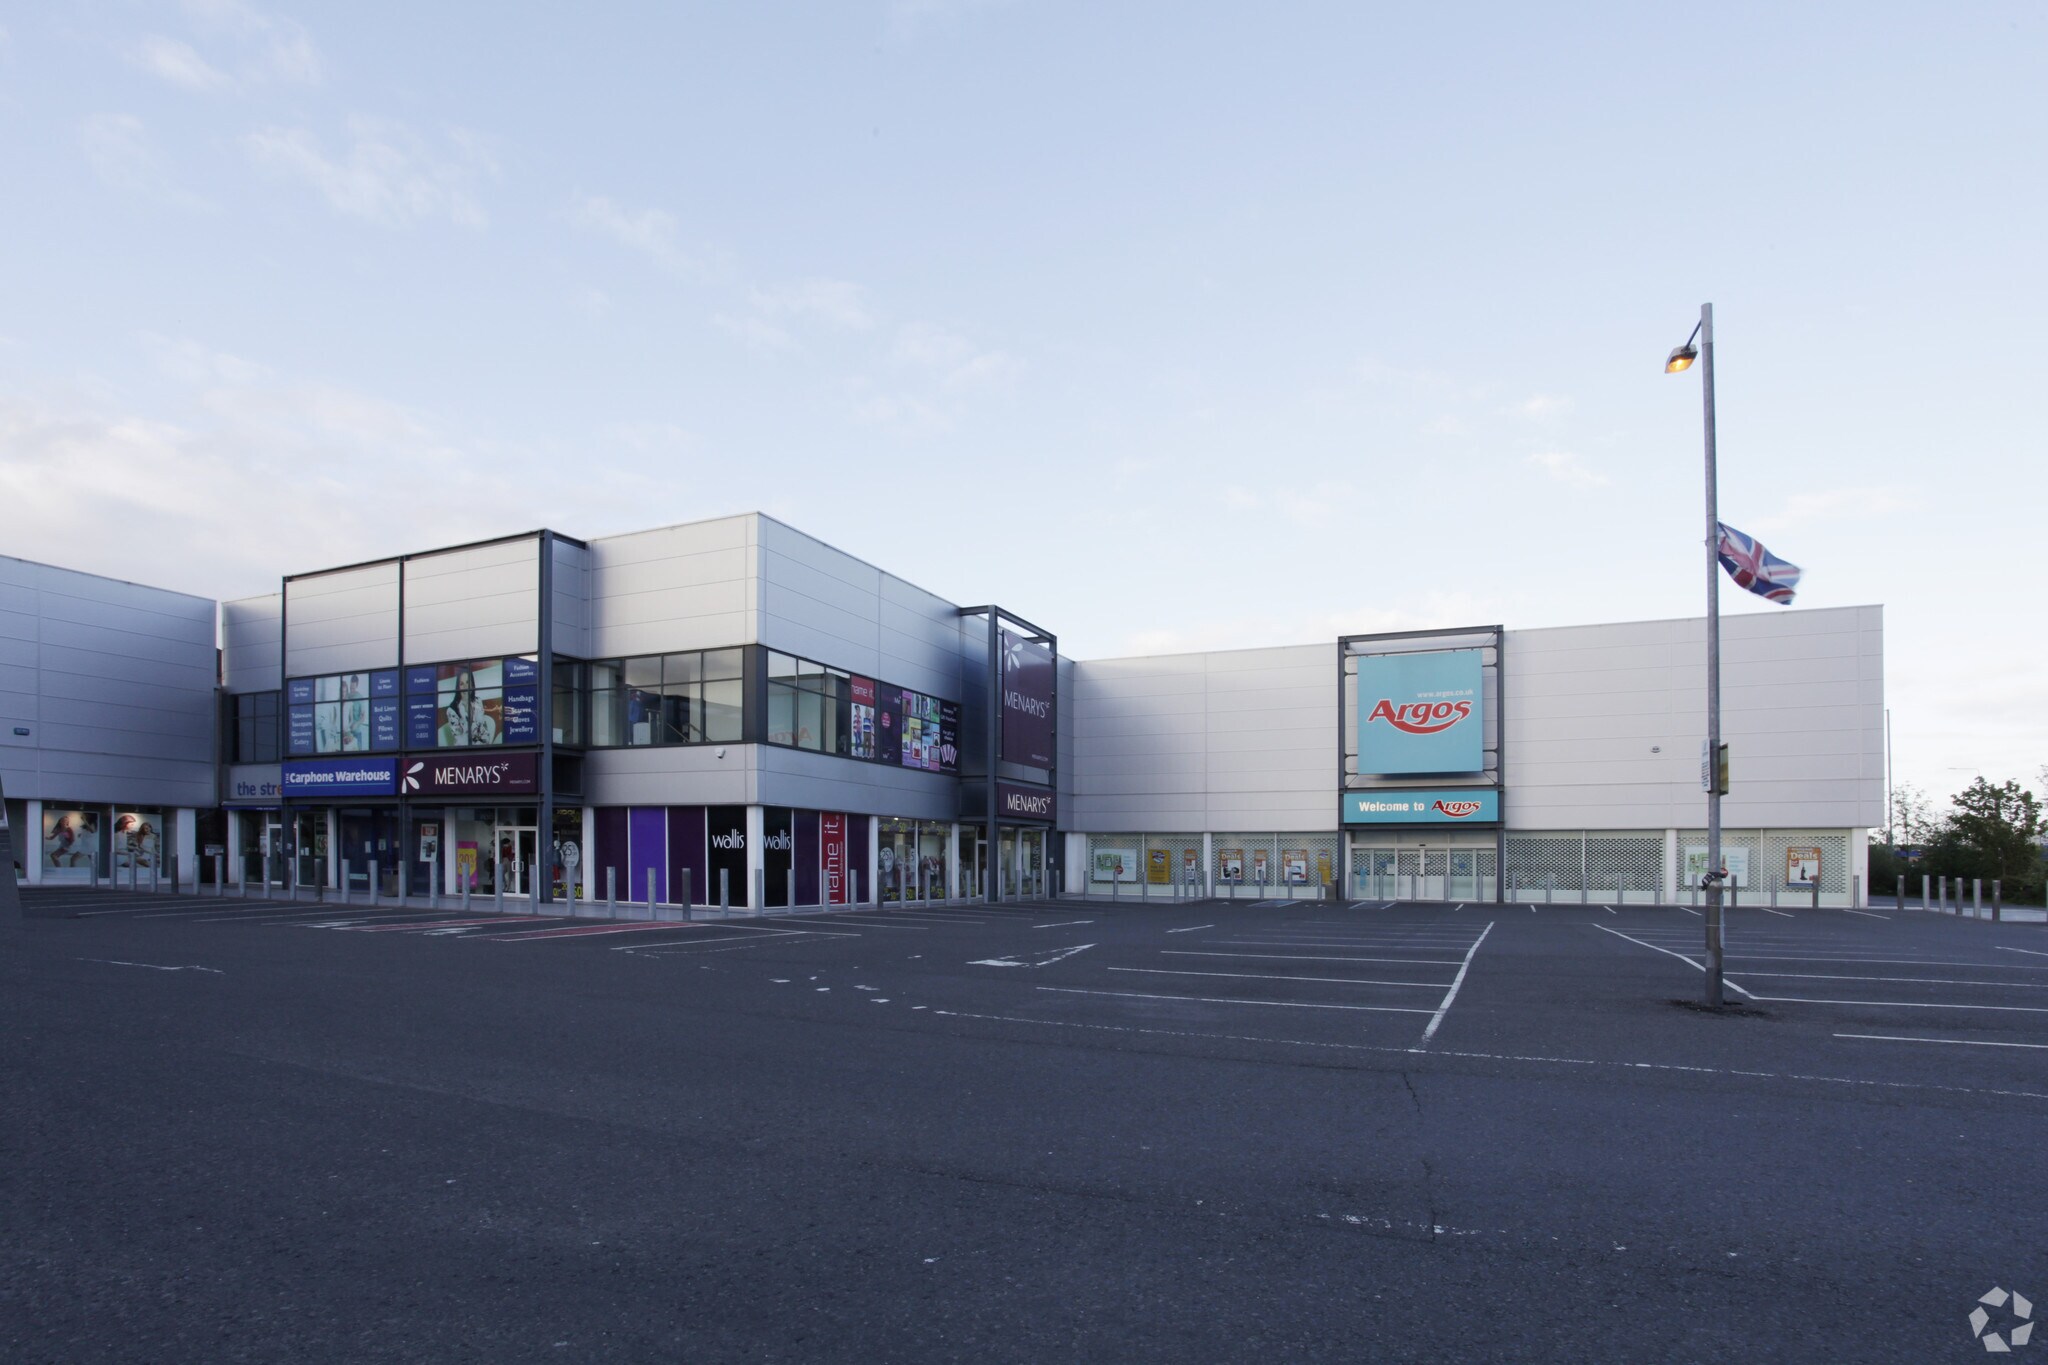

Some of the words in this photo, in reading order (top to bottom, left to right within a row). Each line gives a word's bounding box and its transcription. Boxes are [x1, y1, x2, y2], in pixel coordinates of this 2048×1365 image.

[508, 695, 534, 703] Handbags
[1417, 689, 1473, 698] www.argos.co.uk
[1004, 689, 1045, 718] MENARYS
[1367, 699, 1473, 734] Argos
[509, 725, 534, 735] Jewellery
[289, 772, 334, 785] Carphone
[335, 770, 391, 782] Warehouse
[435, 766, 501, 785] MENARYS
[237, 782, 256, 796] the
[1007, 793, 1047, 814] MENARYS
[1359, 802, 1409, 813] Welcome
[1413, 802, 1425, 812] to
[1431, 800, 1481, 818] Argos
[712, 829, 745, 849] wallis
[763, 829, 791, 850] wallis
[1791, 852, 1818, 860] Deals
